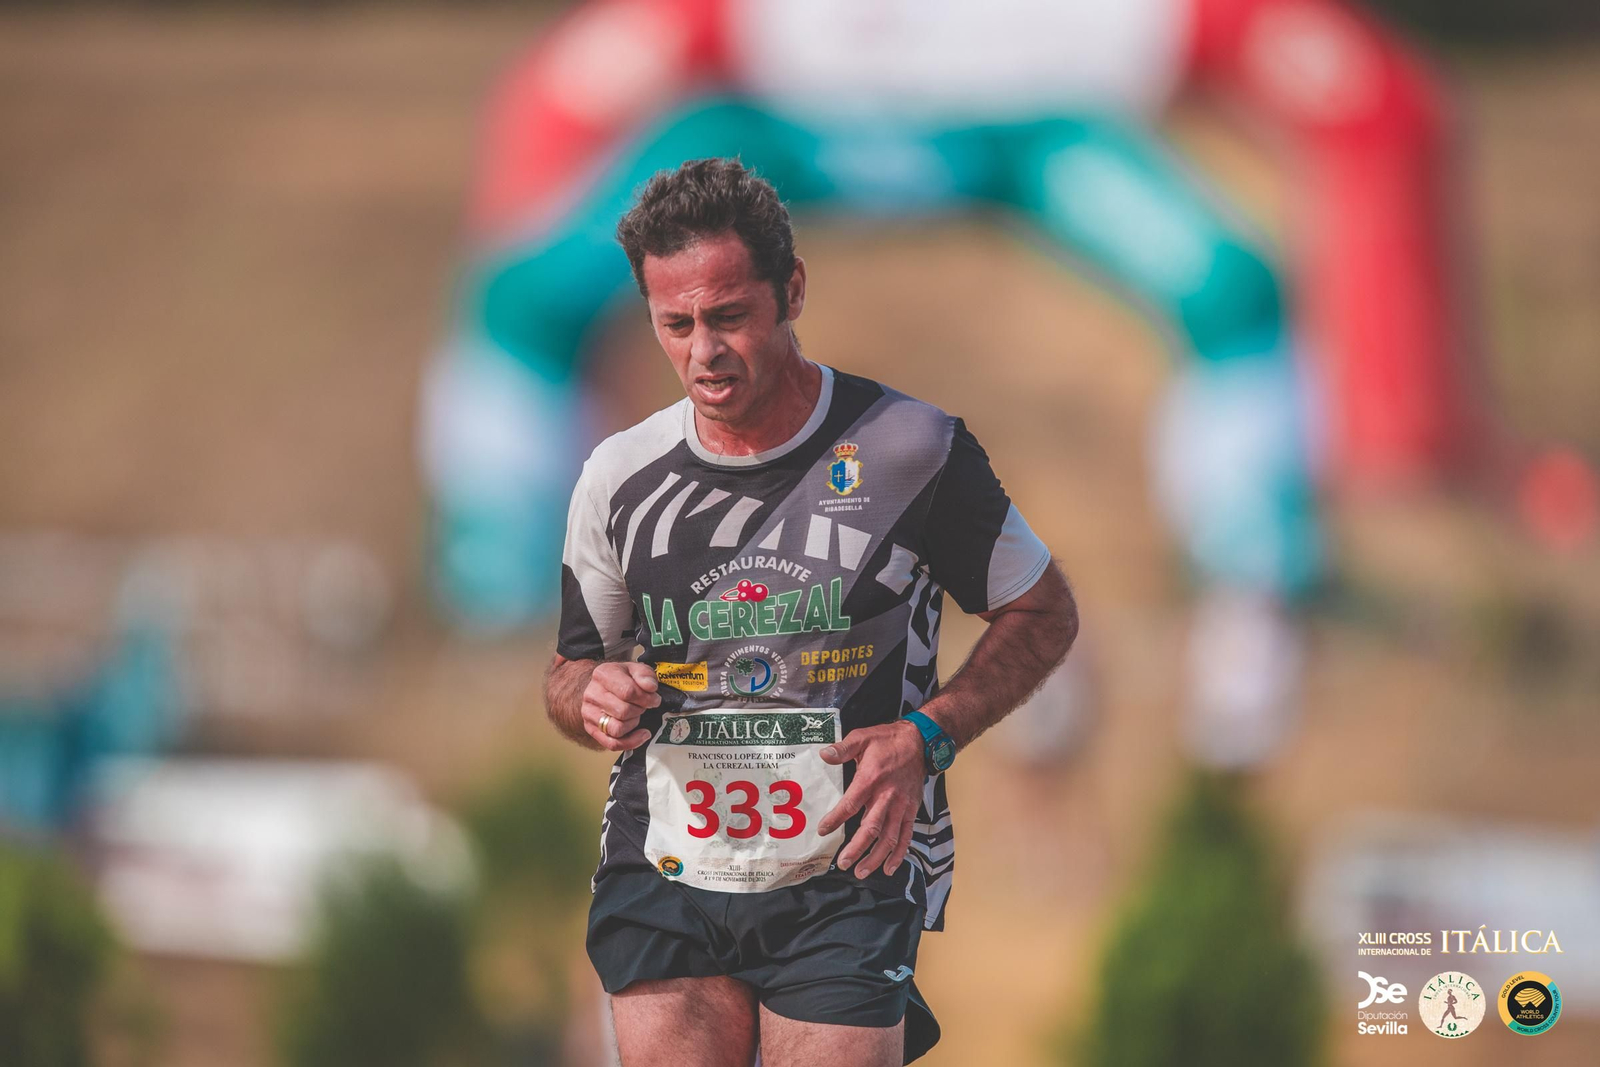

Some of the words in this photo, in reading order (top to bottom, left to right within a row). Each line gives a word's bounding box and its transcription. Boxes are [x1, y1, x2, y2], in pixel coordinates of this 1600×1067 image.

[819, 498, 861, 506] AYUNTAMIENTO
[690, 555, 812, 595] RESTAURANTE
[642, 592, 683, 648] LA
[688, 576, 851, 641] CEREZAL
[724, 644, 770, 668] PAVIMENTOS
[770, 651, 788, 684] VETUSTA
[801, 644, 874, 666] DEPORTES
[807, 663, 868, 684] SOBRINO
[697, 716, 787, 739] ITÁLICA
[801, 735, 824, 743] Sevilla
[688, 752, 733, 760] FRANCISCO
[734, 752, 762, 760] LOPEZ
[763, 752, 774, 760] DE
[775, 752, 796, 760] DIOS
[685, 779, 807, 840] 333
